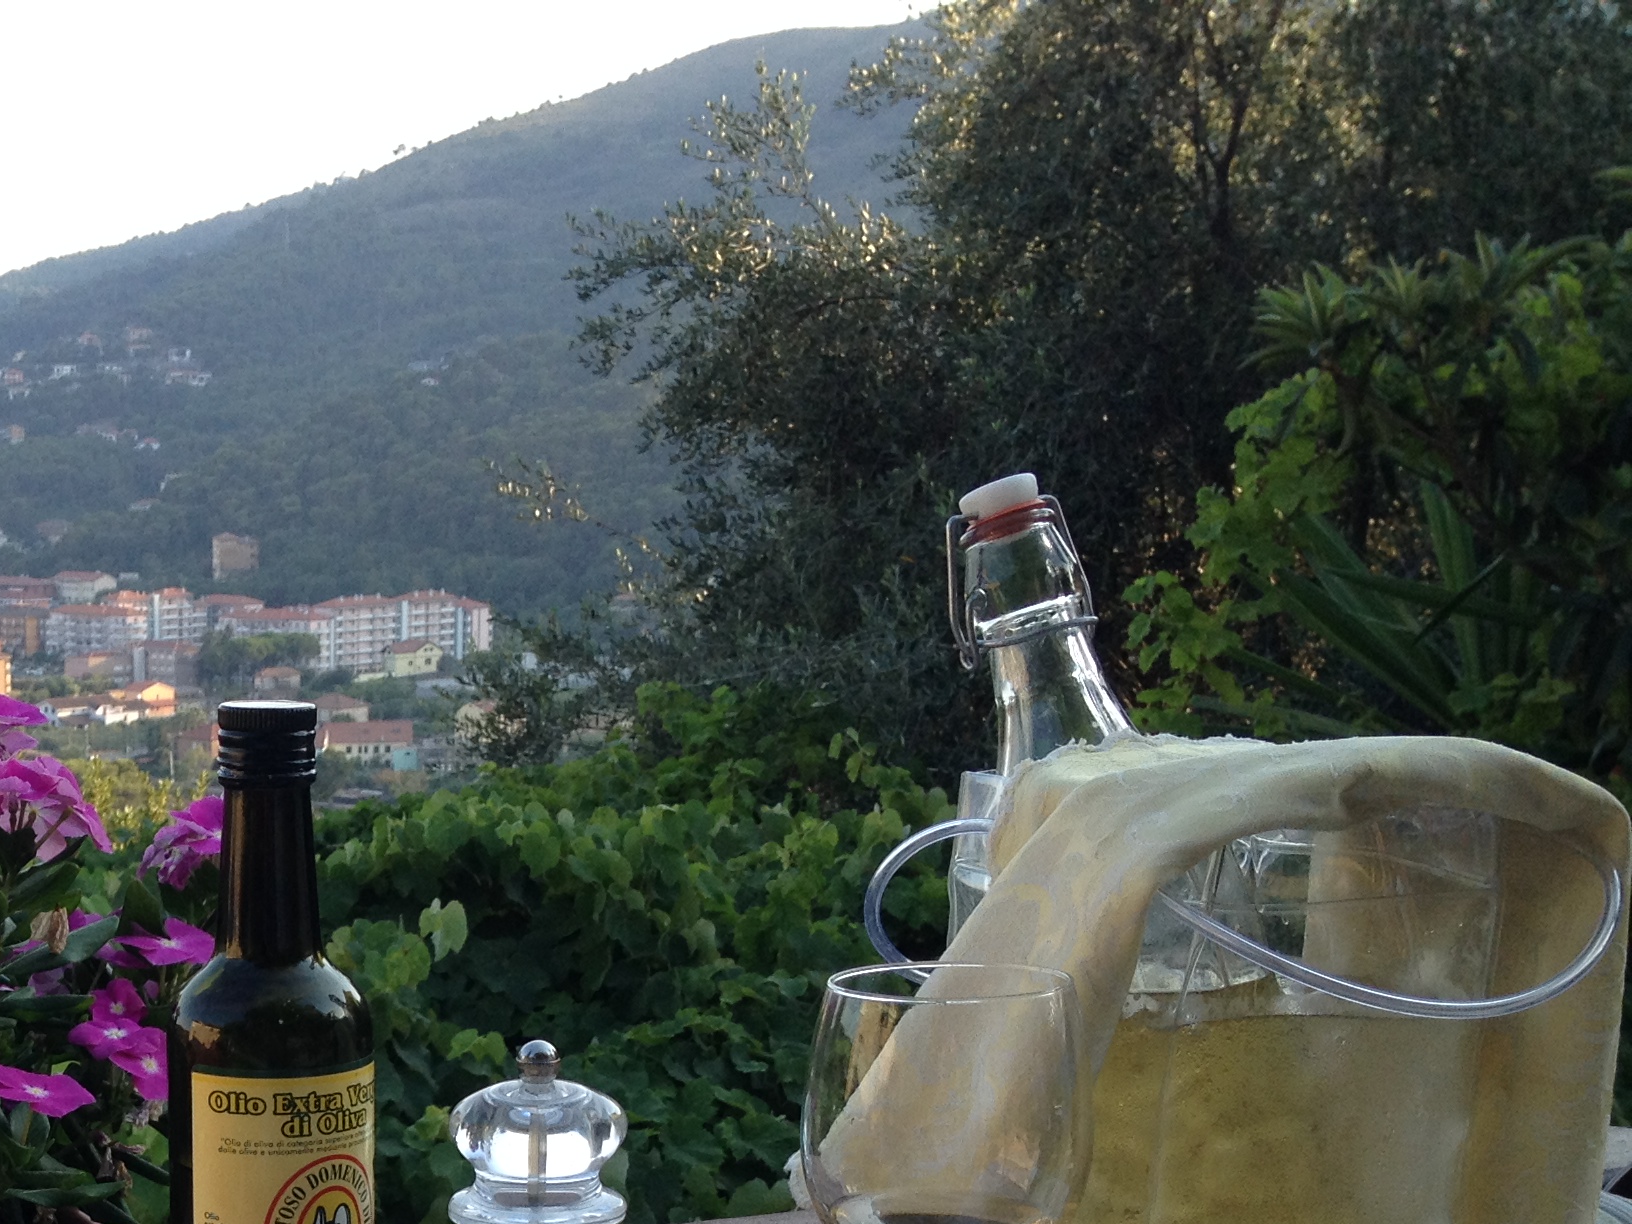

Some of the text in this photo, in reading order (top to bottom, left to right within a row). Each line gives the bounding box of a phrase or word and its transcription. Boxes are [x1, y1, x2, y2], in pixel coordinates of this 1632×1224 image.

[208, 1091, 267, 1116] Olio
[273, 1091, 344, 1116] Extra
[281, 1108, 367, 1138] di Oliva
[305, 1163, 368, 1203] DOMENICO
